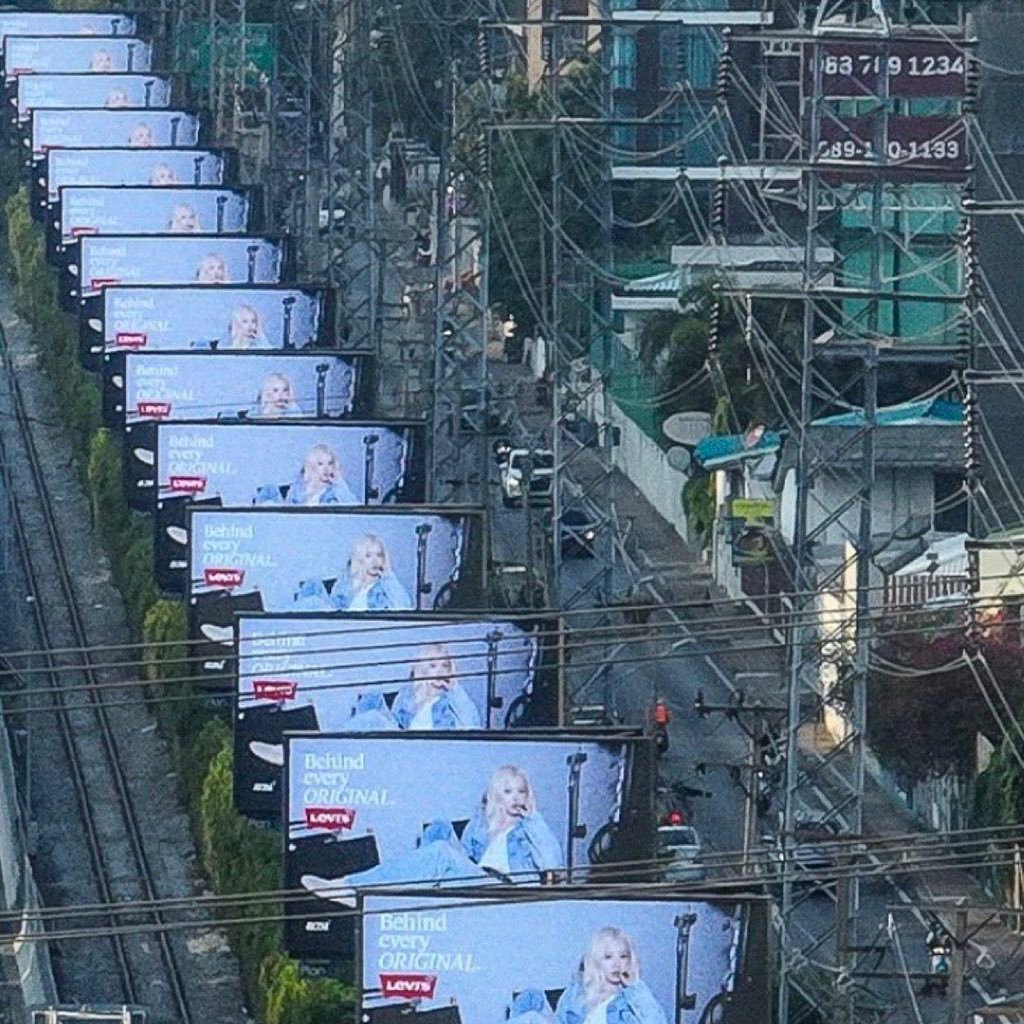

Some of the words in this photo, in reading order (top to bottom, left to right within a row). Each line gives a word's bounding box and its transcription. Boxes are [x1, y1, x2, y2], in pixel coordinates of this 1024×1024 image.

[908, 55, 964, 76] 1234
[304, 753, 365, 771] Behind
[304, 771, 350, 789] every
[379, 913, 447, 932] Behind
[378, 933, 432, 952] every
